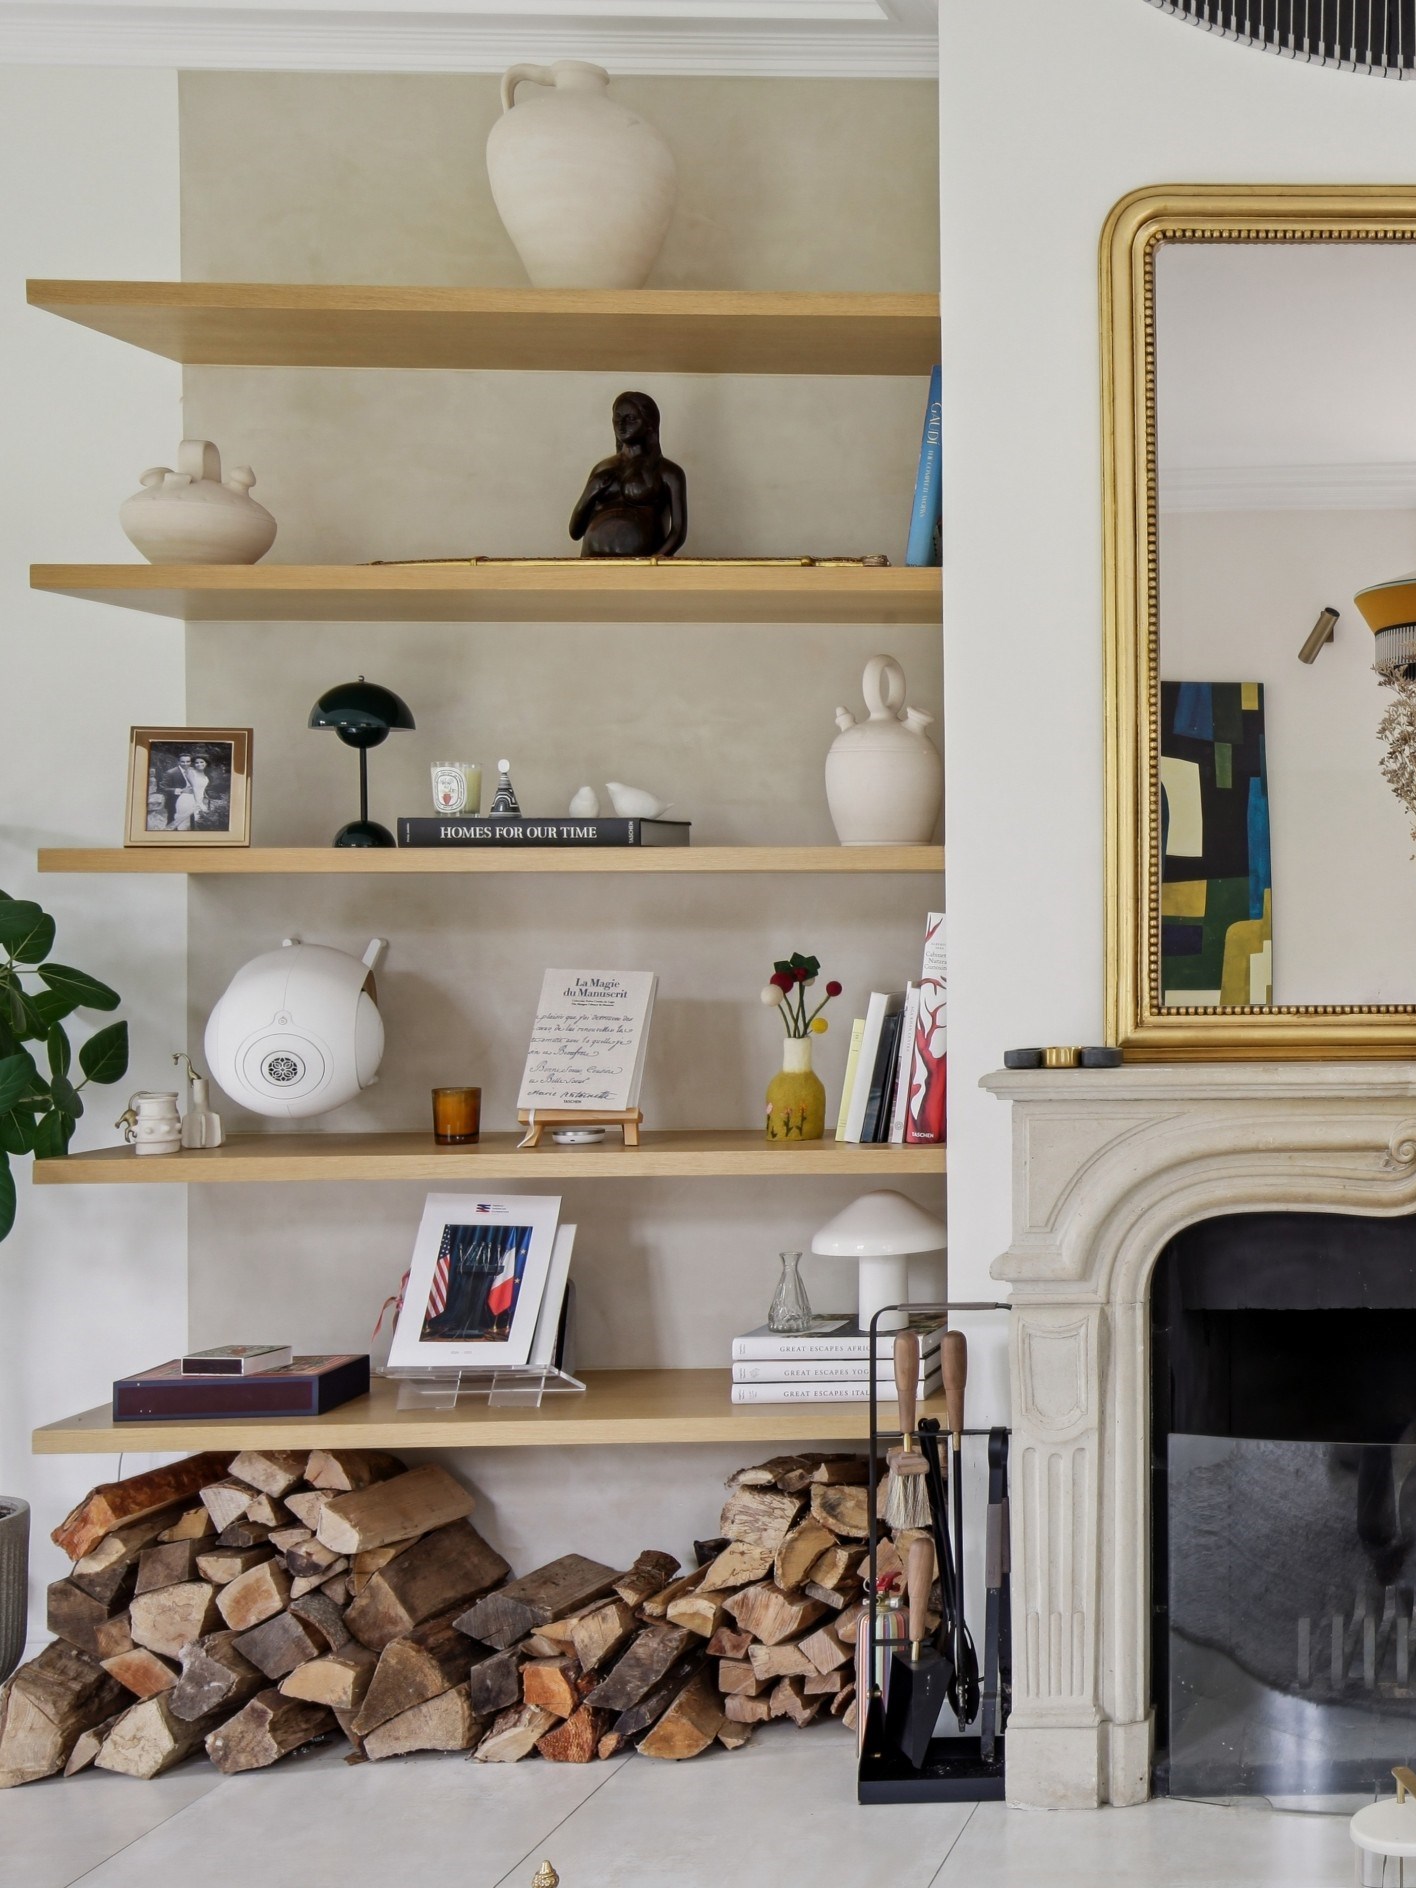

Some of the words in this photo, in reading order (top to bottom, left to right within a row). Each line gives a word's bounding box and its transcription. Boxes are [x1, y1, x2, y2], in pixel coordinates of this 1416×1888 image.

[927, 402, 942, 446] GAUDÍ
[440, 826, 492, 839] HOMES
[495, 826, 523, 839] FOR
[526, 826, 557, 839] OUR
[560, 826, 597, 838] TIME
[575, 977, 588, 988] La
[590, 978, 621, 990] Magie
[563, 987, 577, 997] du
[579, 988, 628, 999] Manuscrit
[911, 1131, 934, 1139] TASCHEN
[779, 1345, 806, 1353] GREAT
[784, 1369, 811, 1377] GREAT
[852, 1368, 870, 1376] YOG
[783, 1390, 811, 1398] GREAT
[851, 1389, 870, 1397] ITAL
